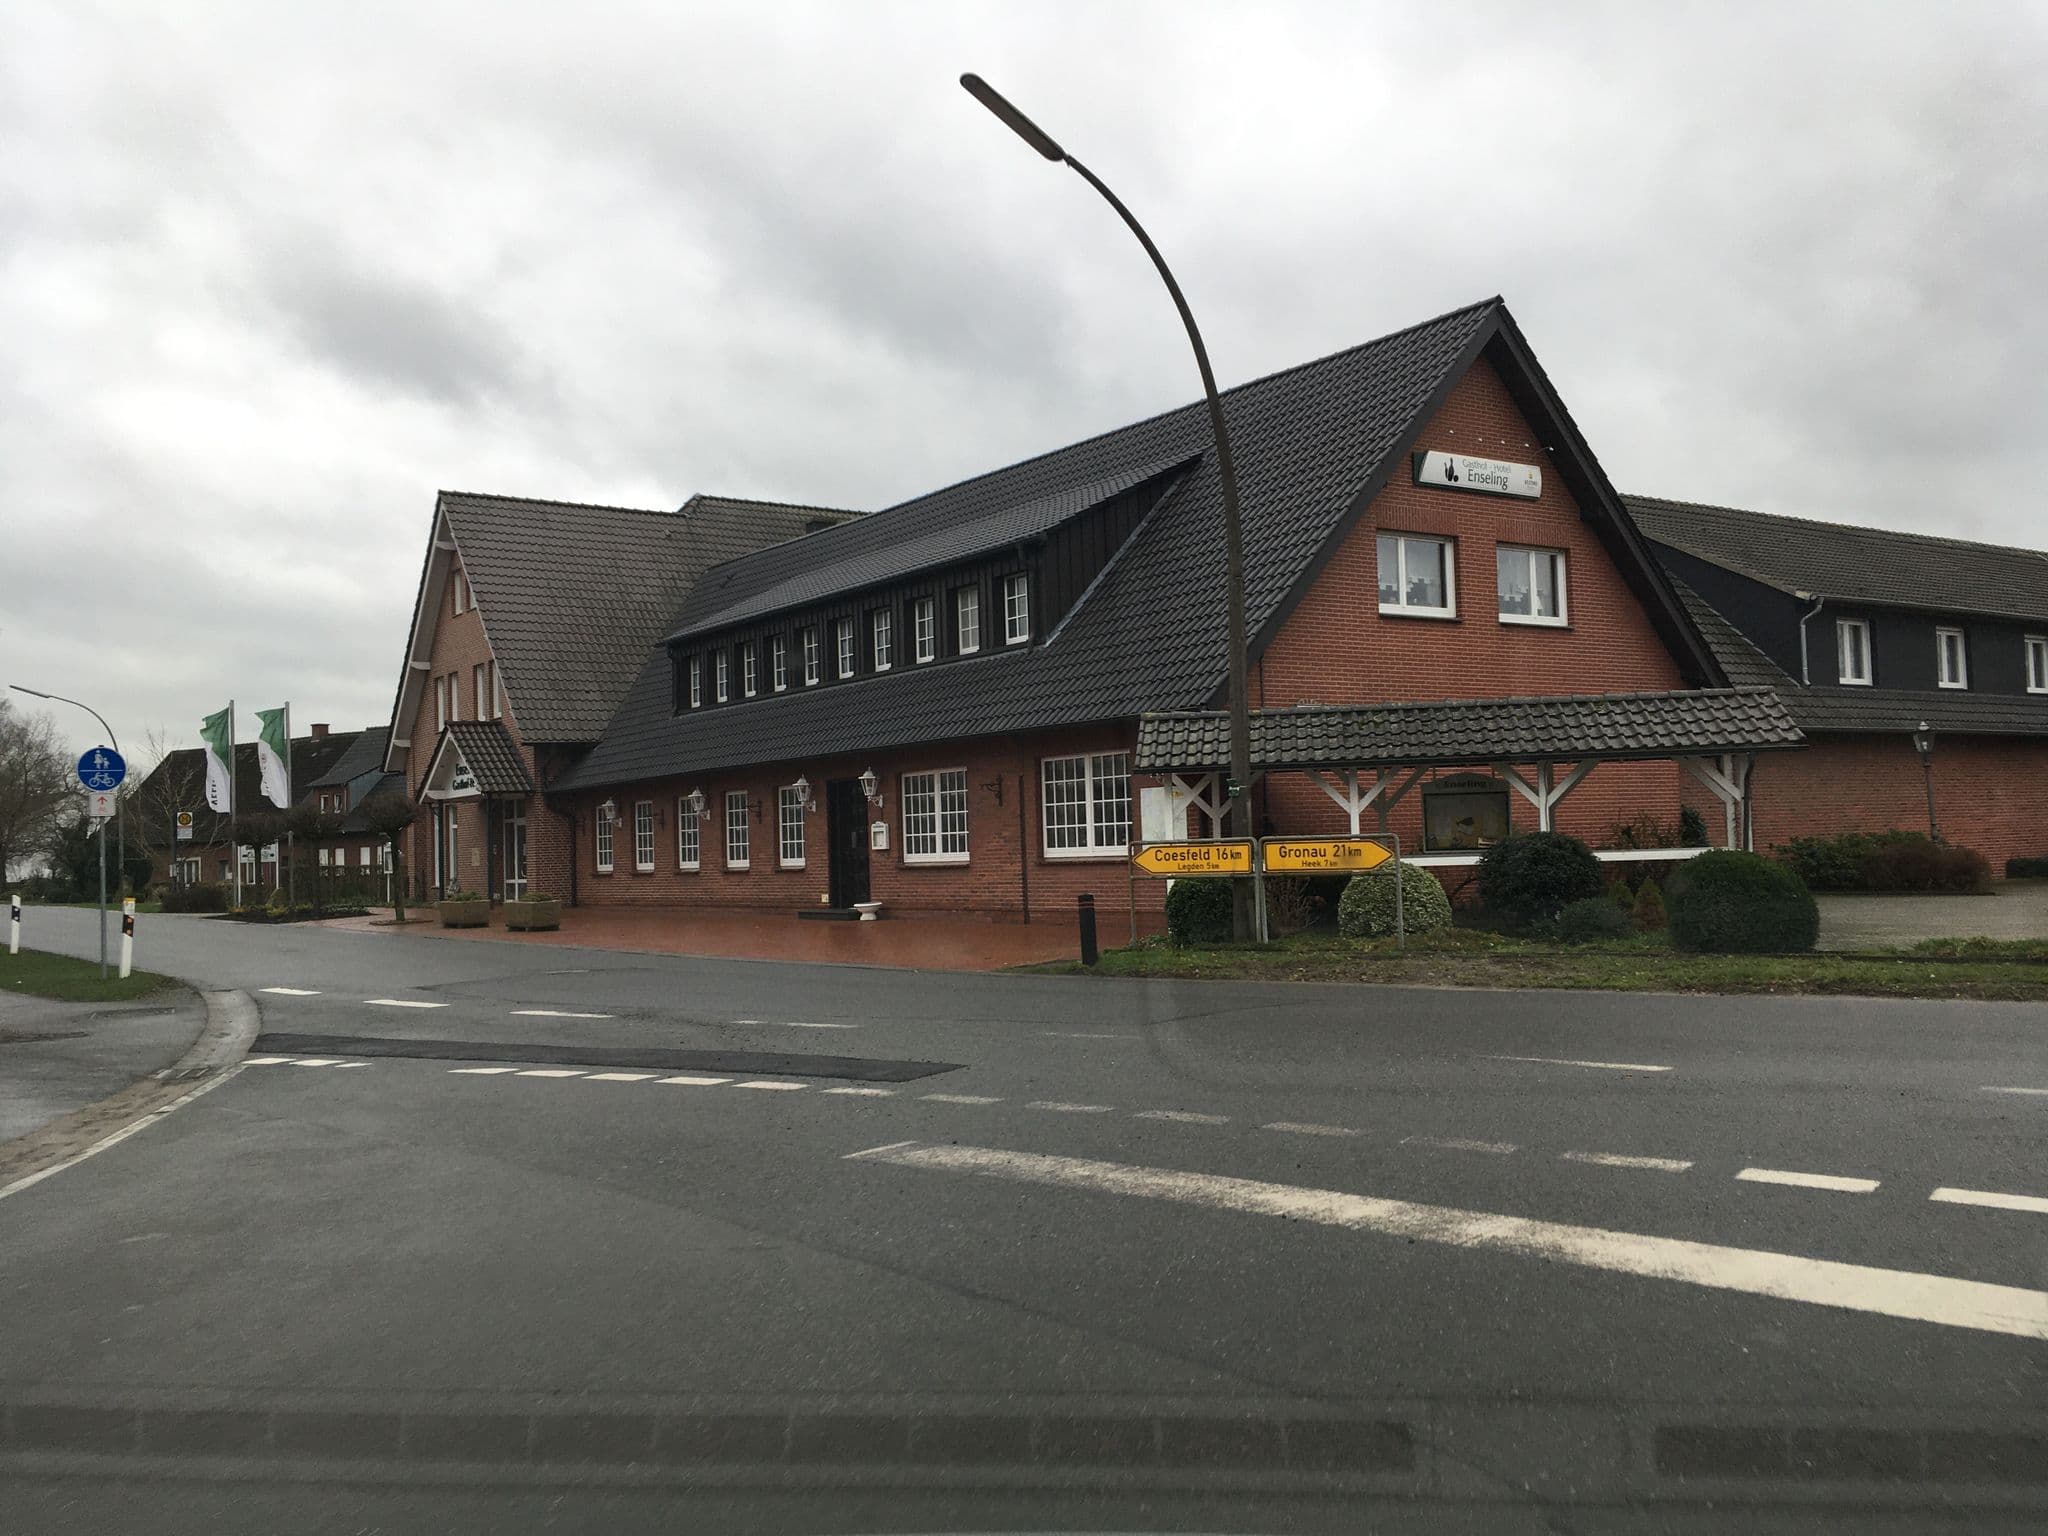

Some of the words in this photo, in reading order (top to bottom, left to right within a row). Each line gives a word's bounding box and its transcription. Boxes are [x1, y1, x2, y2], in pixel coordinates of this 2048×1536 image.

[1467, 469, 1509, 490] Enseling
[1154, 848, 1211, 861] Coesfeld
[1279, 845, 1327, 858] Gronau
[1177, 863, 1205, 872] Legden
